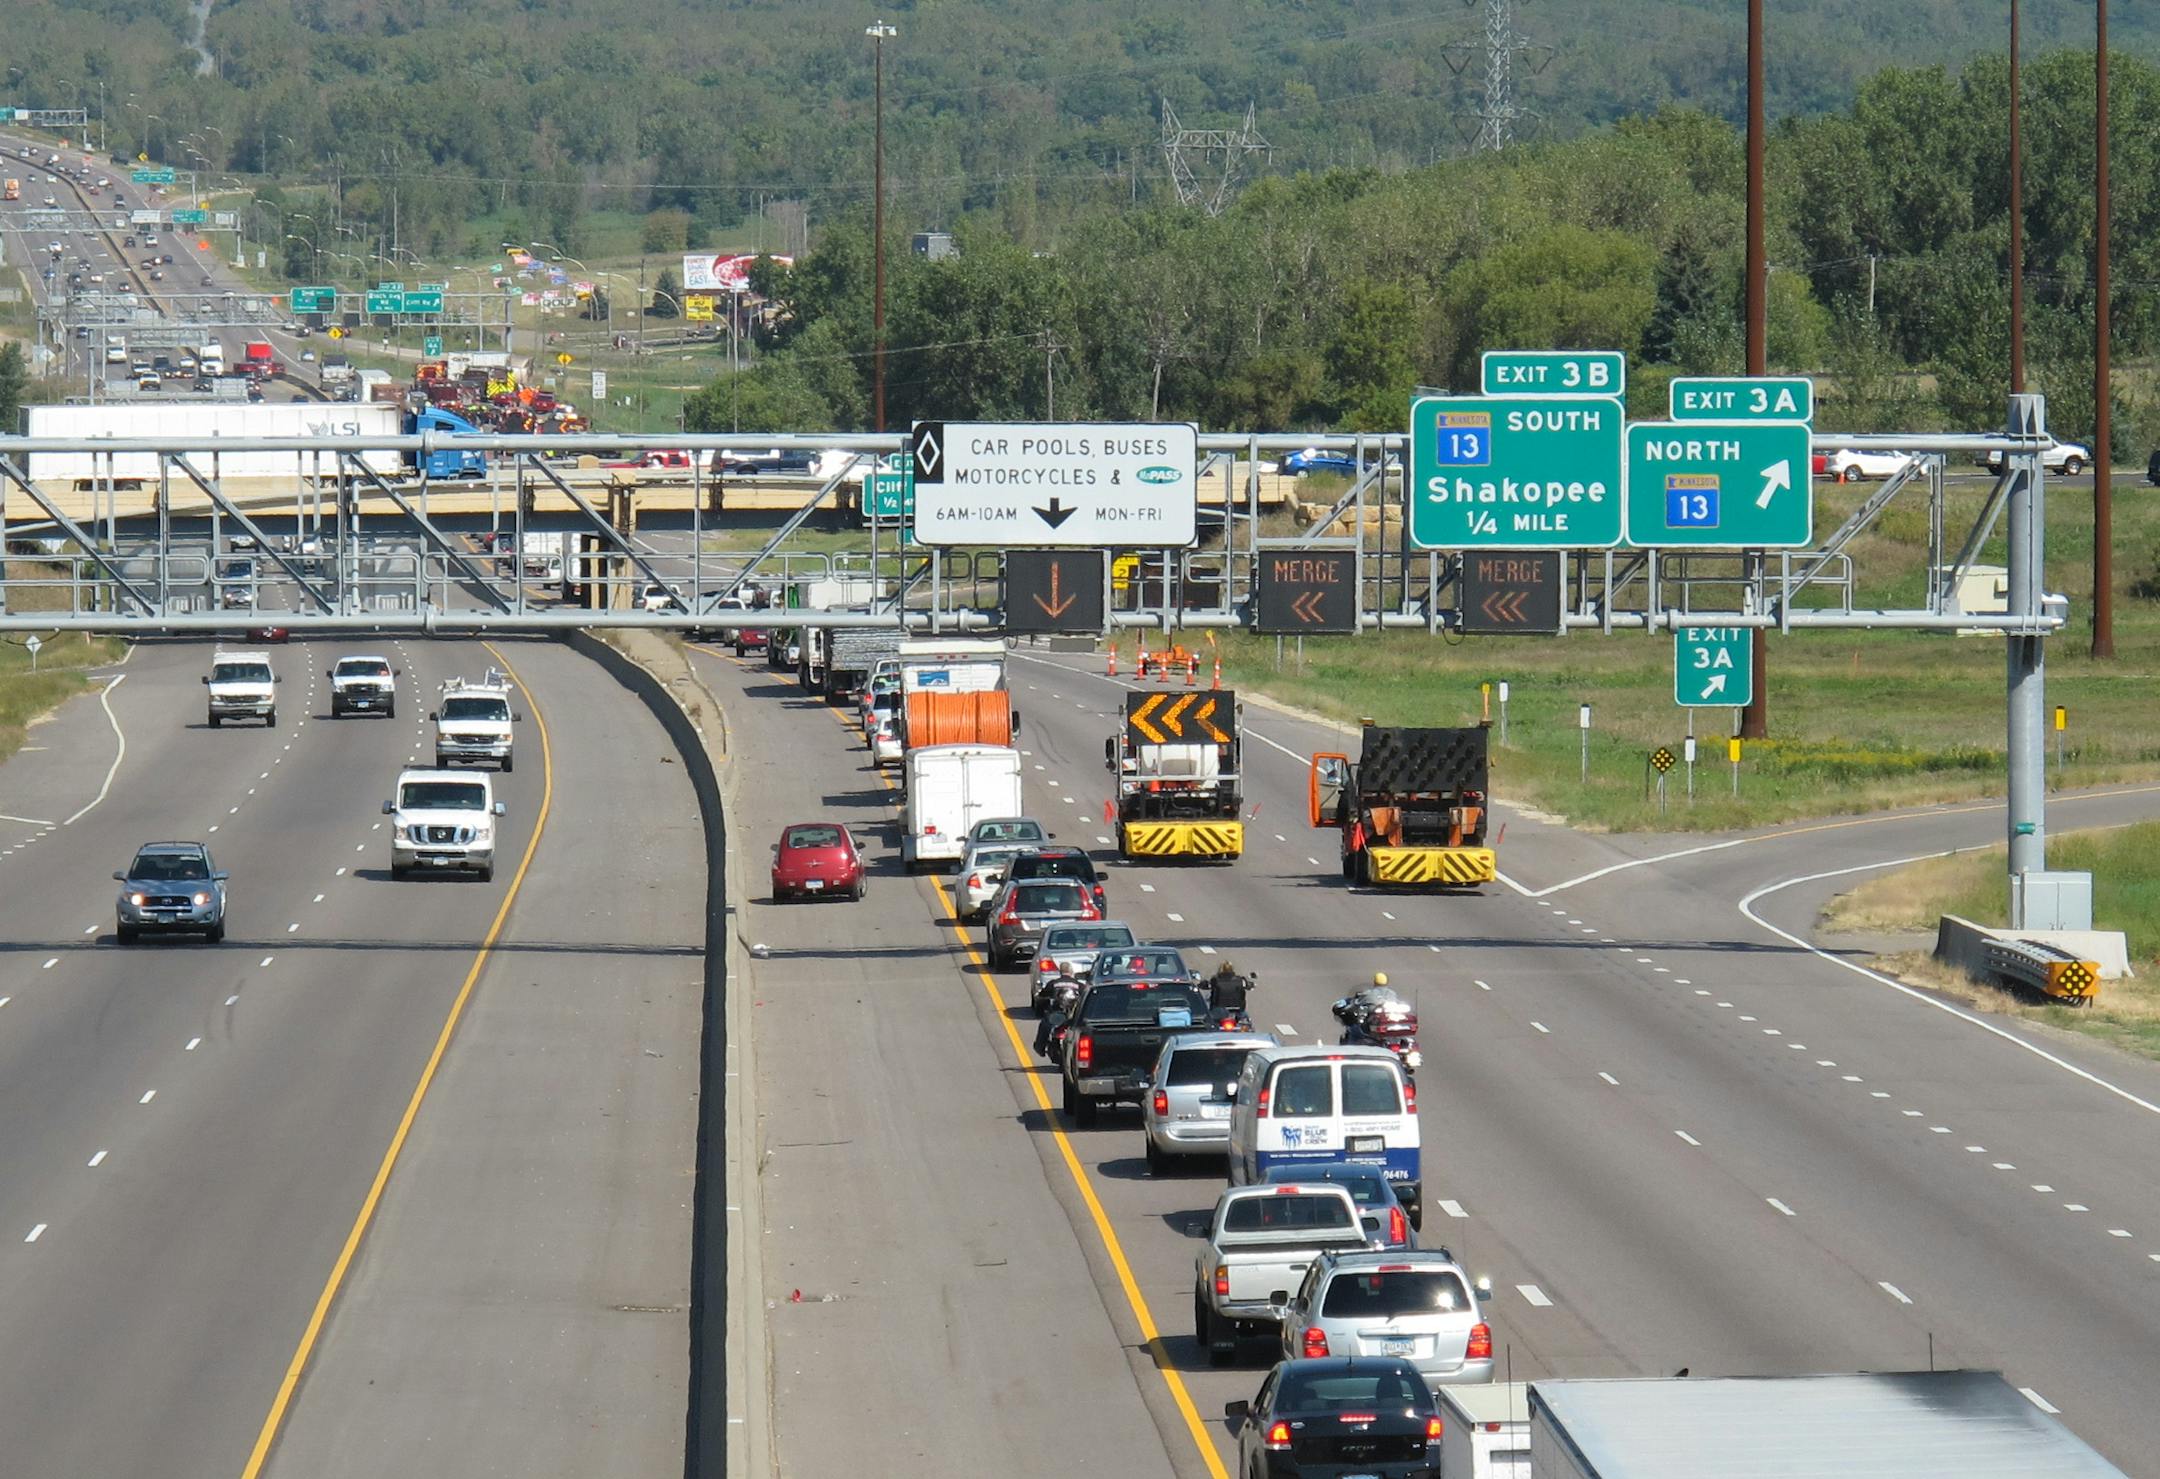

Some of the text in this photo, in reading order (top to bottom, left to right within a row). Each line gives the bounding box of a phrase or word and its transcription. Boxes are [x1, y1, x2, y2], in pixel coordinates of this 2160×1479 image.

[1497, 362, 1609, 386] EXIT 3B
[1684, 388, 1797, 413] EXIT 3A
[331, 422, 360, 436] LSI
[1450, 415, 1488, 425] MINNESOTA
[1507, 411, 1600, 431] SOUTH
[971, 439, 1167, 458] CAR POOLS, BUSES
[1451, 433, 1479, 458] 13
[1646, 441, 1740, 461] NORTH
[955, 469, 1096, 485] MOTORCYCLES
[1110, 469, 1120, 485] &
[1679, 478, 1717, 487] MINNESOTA
[1428, 476, 1606, 507] Shakopee
[936, 507, 1162, 520] 6AM-10AM MON-FRI
[1680, 495, 1709, 520] 13
[1514, 514, 1568, 531] MILE
[1275, 560, 1339, 582] MERGE
[1478, 560, 1543, 582] MERGE
[1688, 627, 1741, 641] EXIT
[1693, 647, 1733, 668] 3A
